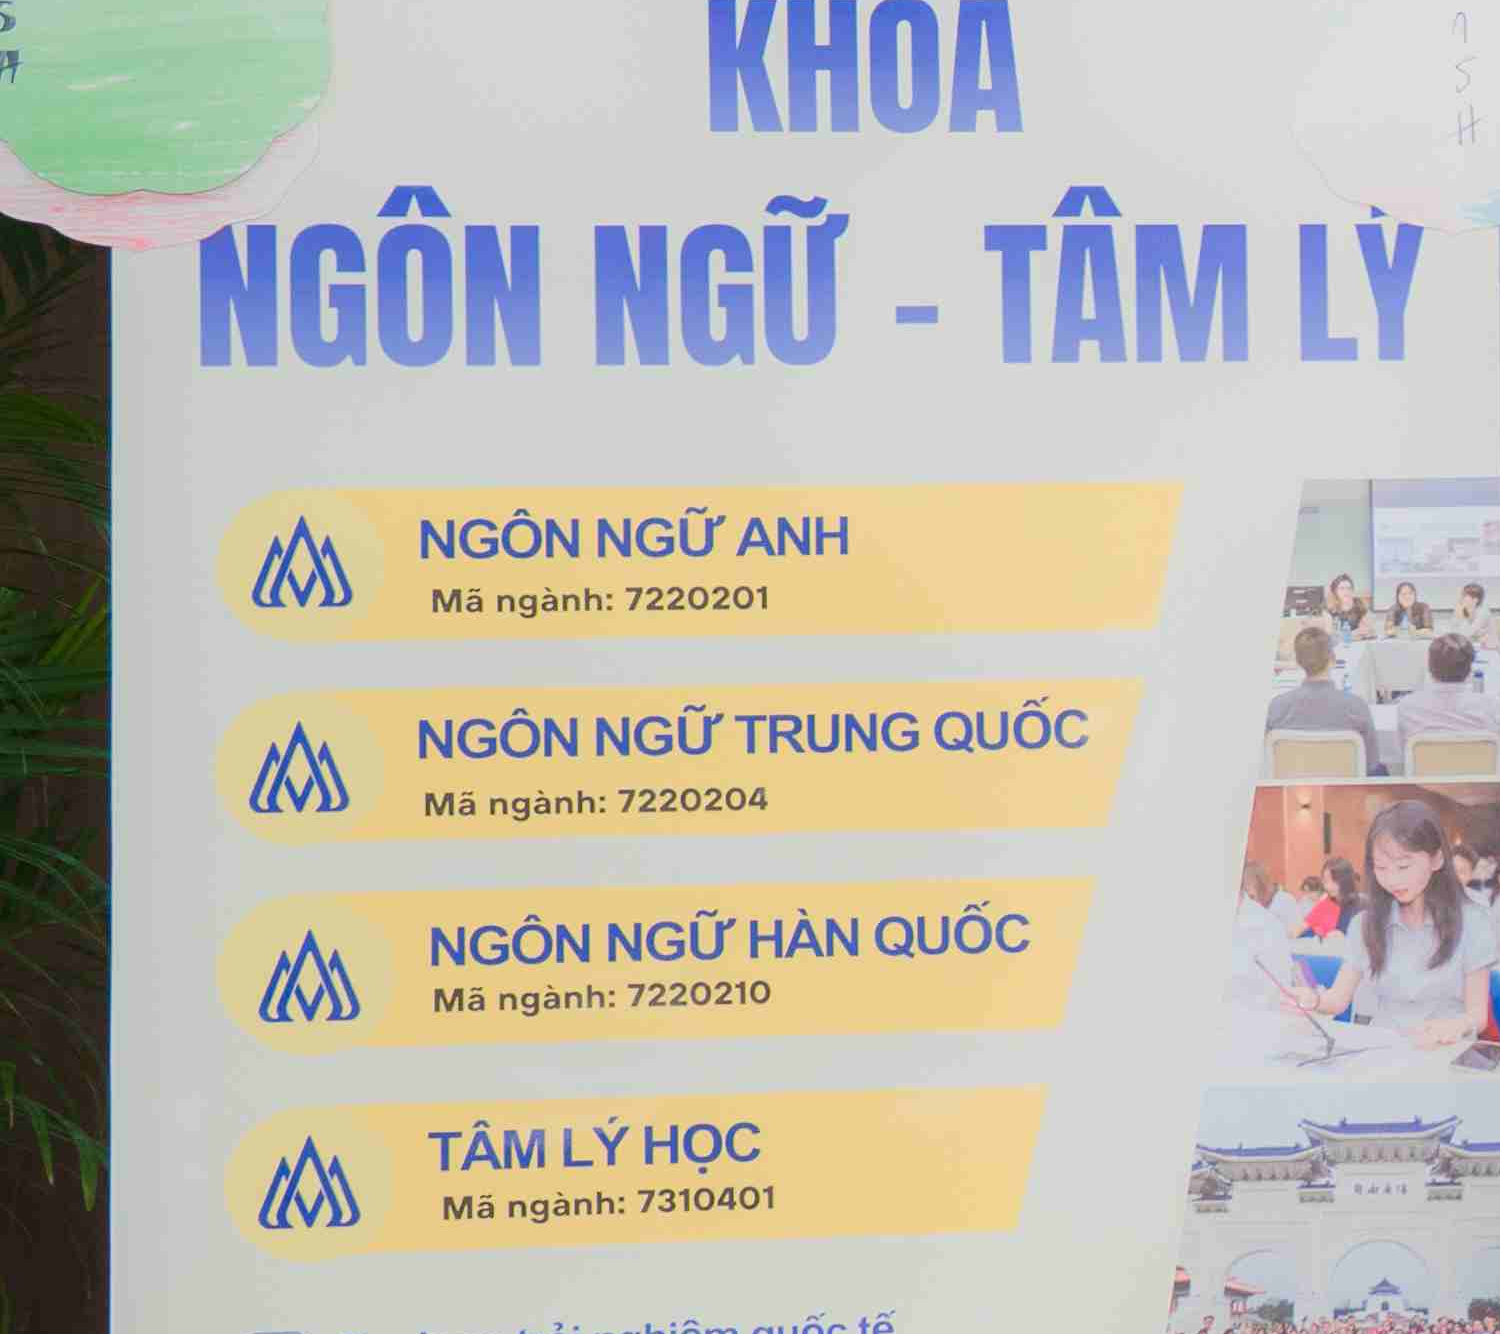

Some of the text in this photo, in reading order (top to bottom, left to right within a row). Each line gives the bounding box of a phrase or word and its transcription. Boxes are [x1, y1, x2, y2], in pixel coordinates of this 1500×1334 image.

[200, 185, 542, 368] NGÔN
[594, 195, 849, 366] NGỮ
[984, 186, 1248, 363] TÂM
[421, 507, 848, 559] NGÔN NGỮ ANH
[433, 586, 767, 618] Mã ngành: 7220201
[419, 697, 1088, 759] NGÔN NGỮ TRUNG QUỐC
[425, 787, 768, 821] Mã ngành: 7220204
[432, 901, 1030, 966] NGÔN NGỮ HÀN QUỐC
[435, 980, 771, 1017] Mã ngành: 7220210
[428, 1116, 760, 1174] TÂM LÝ HỌC
[444, 1186, 773, 1223] Mã ngành: 7310401
